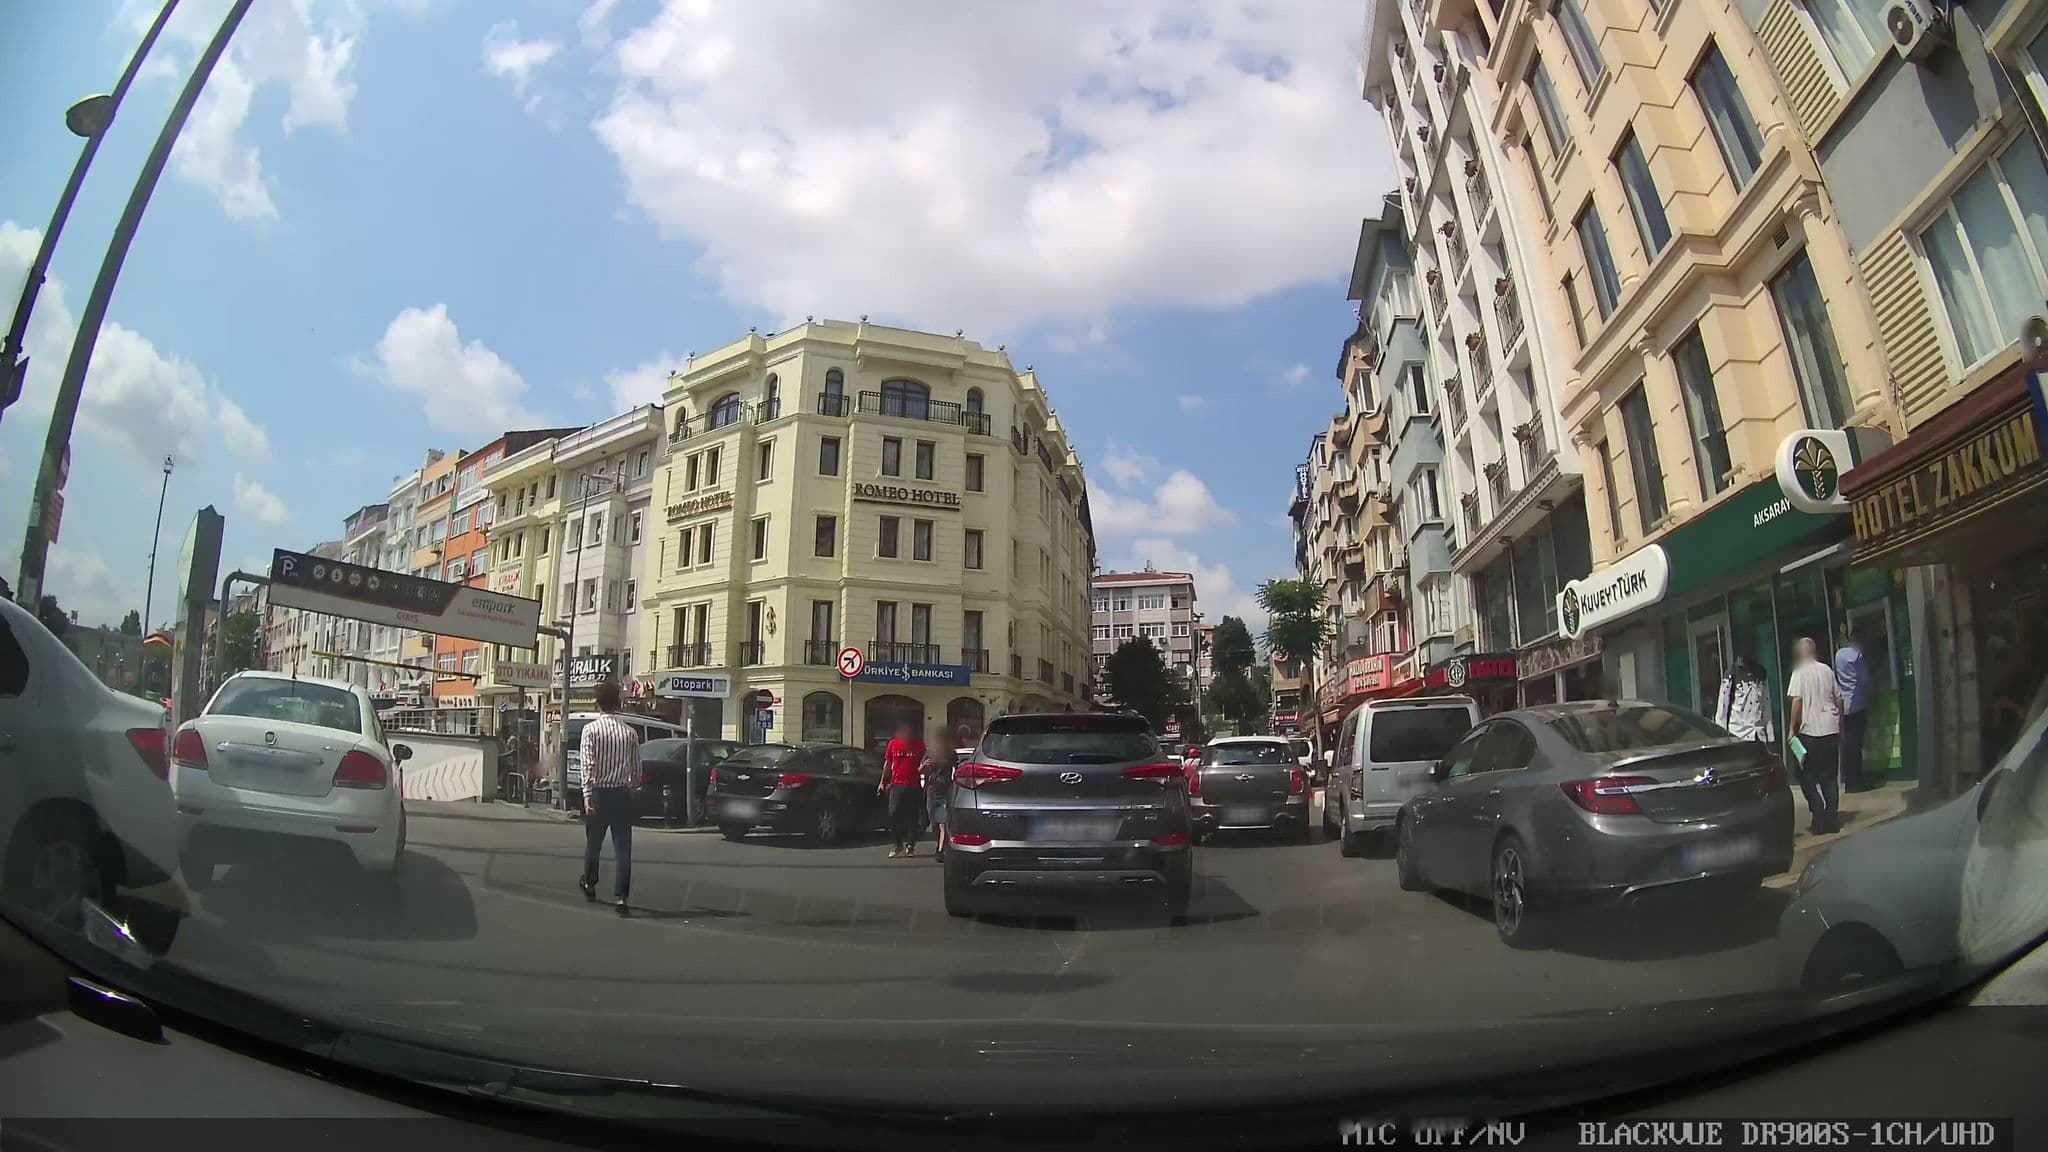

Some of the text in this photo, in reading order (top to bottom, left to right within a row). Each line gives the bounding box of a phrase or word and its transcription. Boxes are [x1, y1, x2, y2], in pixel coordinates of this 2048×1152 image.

[1853, 412, 2039, 541] HOTEL ZAKKUM
[855, 483, 960, 505] ROMEO HOTEL
[667, 491, 735, 517] ROMEO HOTEL
[1753, 498, 1792, 528] AKSARAY
[472, 598, 516, 614] empark
[496, 665, 513, 678] OTO
[516, 667, 549, 680] YIKAMA
[864, 665, 900, 676] ÜRKİYE
[912, 669, 953, 679] BANKASI
[672, 678, 712, 691] Otopark
